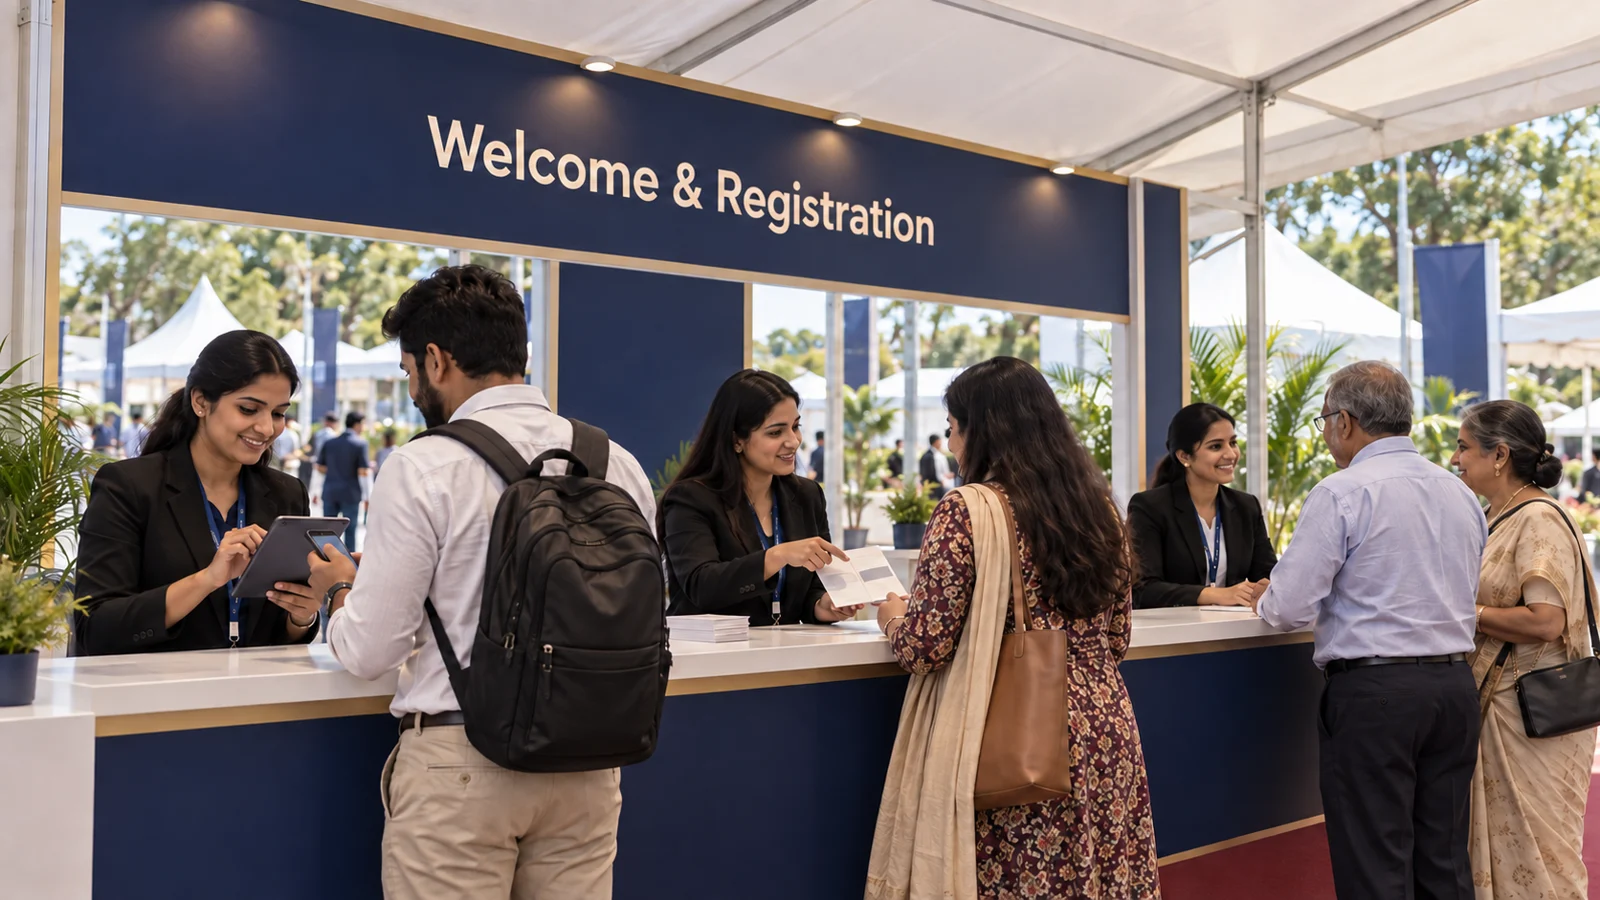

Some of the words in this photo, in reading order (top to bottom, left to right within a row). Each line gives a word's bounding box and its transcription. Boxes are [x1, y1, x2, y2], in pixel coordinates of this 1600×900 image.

[427, 114, 659, 202] Welcome
[672, 162, 703, 210] &
[717, 168, 935, 247] Registration
